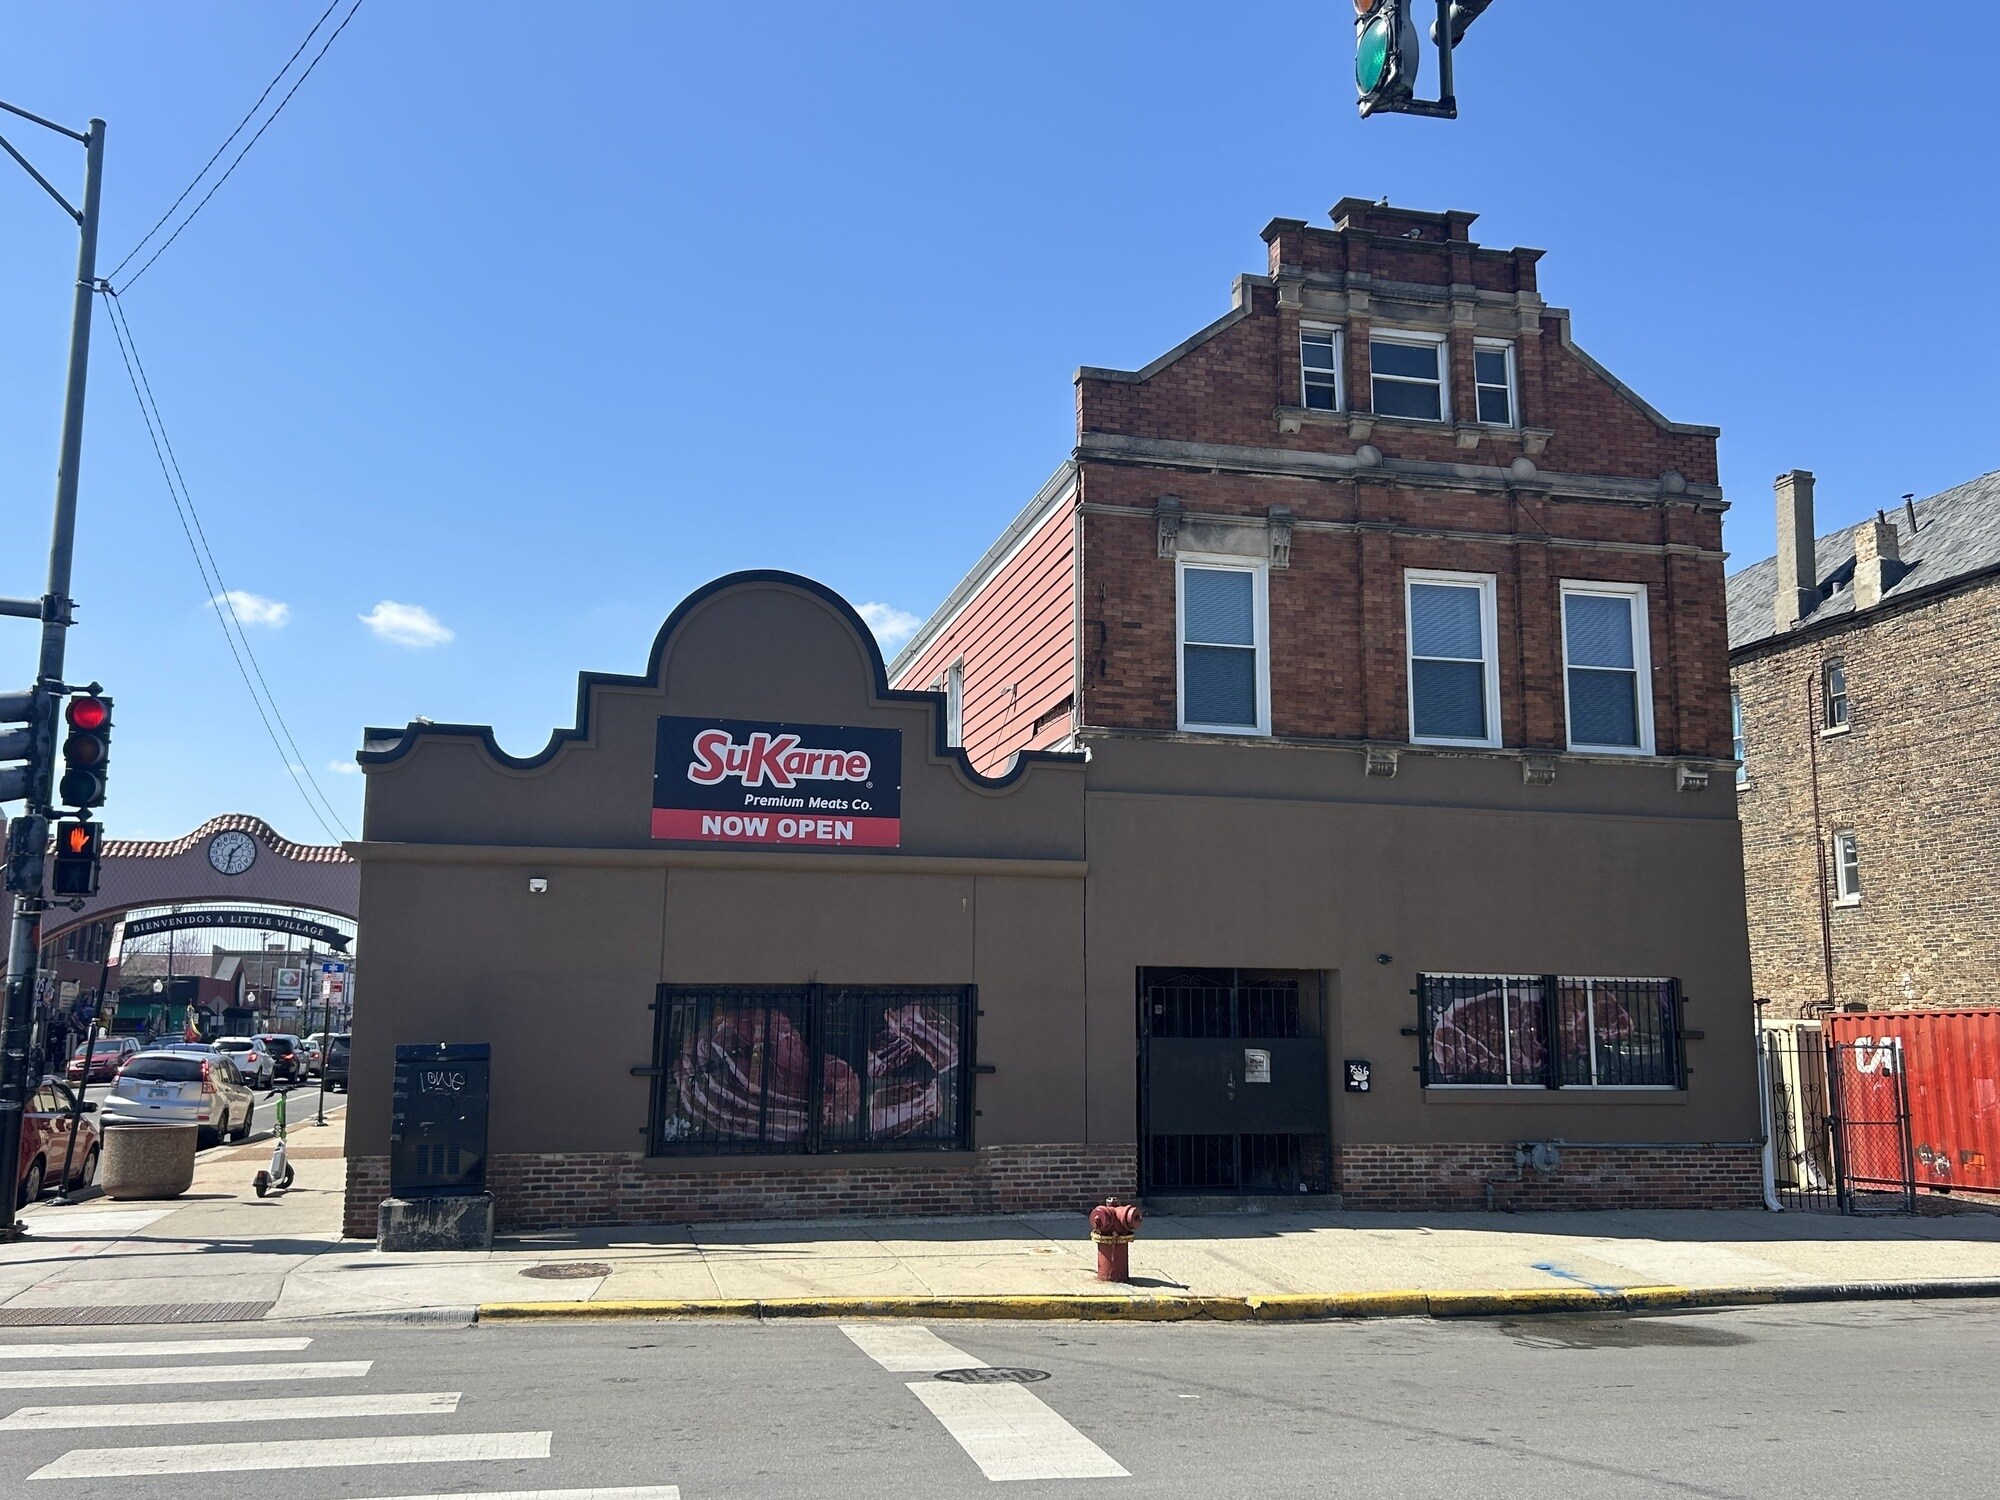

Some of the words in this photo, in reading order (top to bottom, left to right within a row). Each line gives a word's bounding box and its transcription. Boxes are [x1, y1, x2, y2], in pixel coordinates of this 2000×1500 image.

[688, 729, 871, 788] SuKarne
[744, 793, 804, 808] Premium
[808, 796, 848, 810] Meats
[852, 798, 873, 811] Co.
[701, 815, 769, 837] NOW
[778, 819, 854, 840] OPEN
[133, 915, 212, 933] BIENVENIDOS
[217, 915, 224, 923] A
[230, 915, 272, 926] LITTLE
[277, 919, 325, 937] VILLAGE
